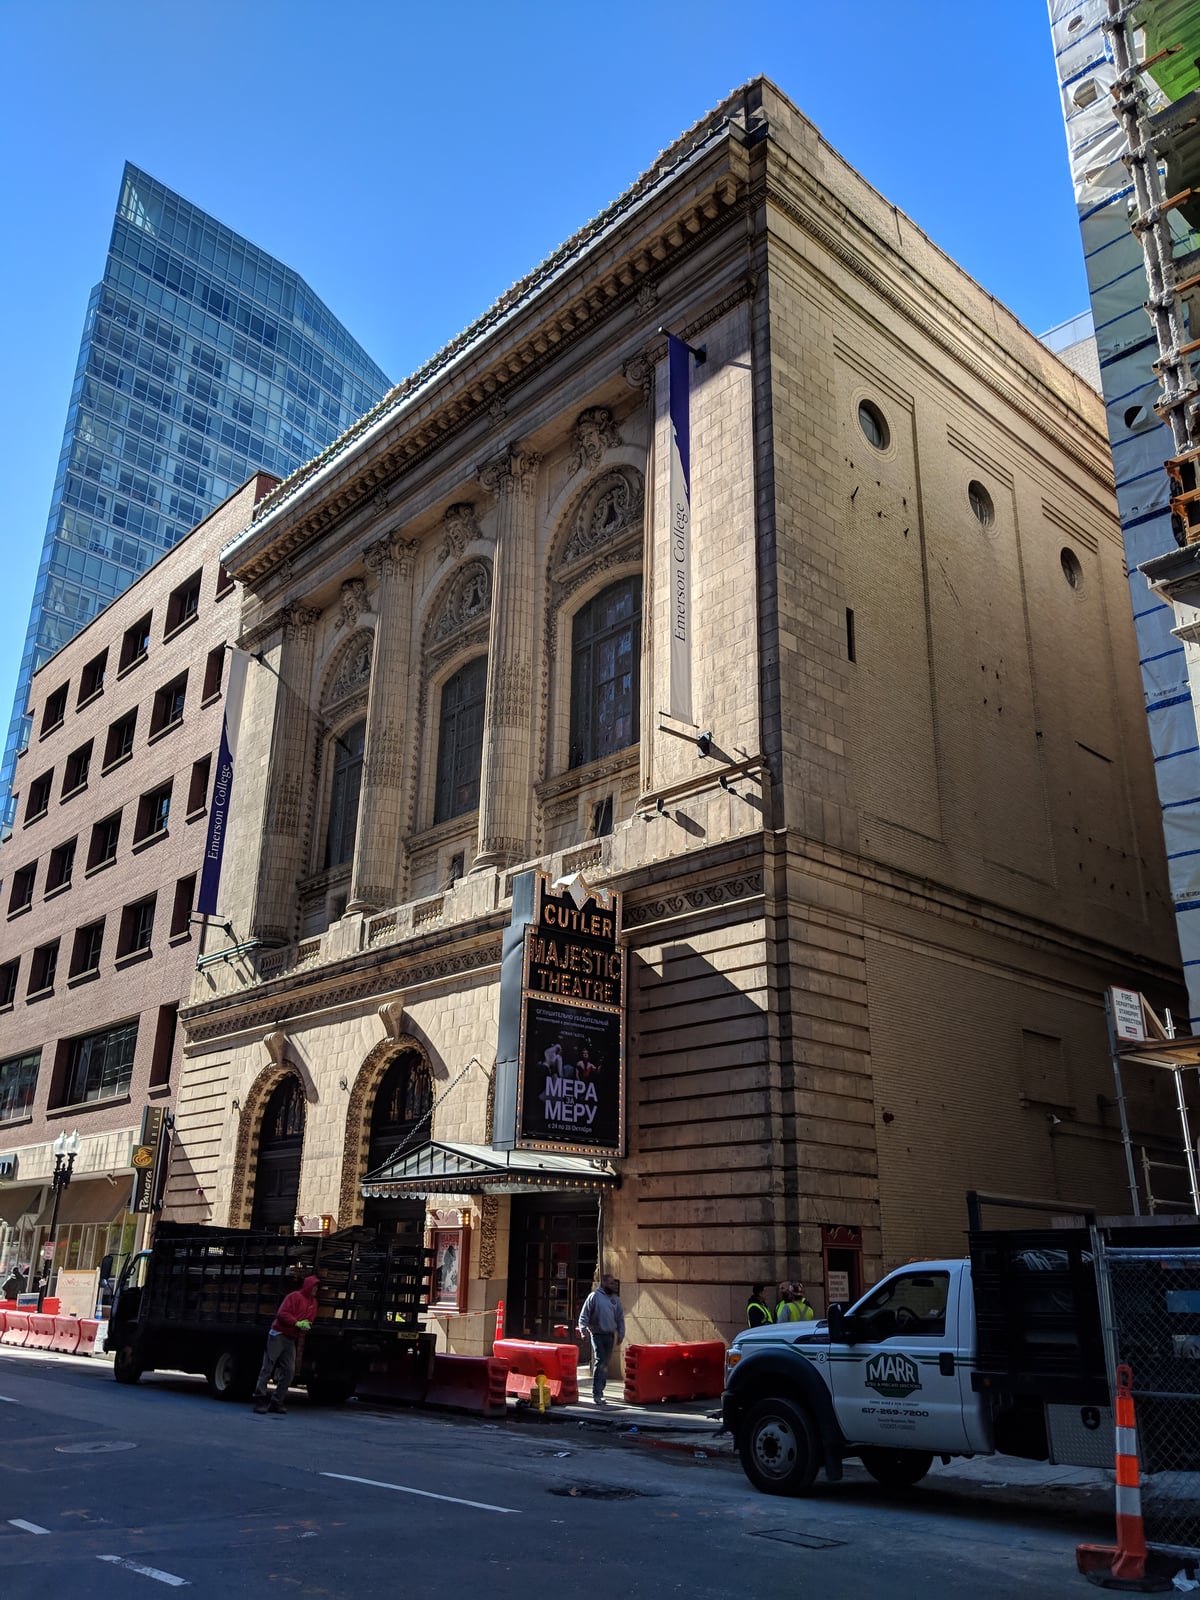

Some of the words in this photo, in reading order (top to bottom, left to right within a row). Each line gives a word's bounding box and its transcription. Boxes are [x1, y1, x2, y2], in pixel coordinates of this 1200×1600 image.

[673, 503, 689, 563] College
[674, 569, 686, 642] Emerson
[214, 764, 232, 806] College
[207, 810, 224, 860] Emerson
[544, 903, 612, 938] CUTLER
[529, 934, 621, 980] MAJESTIC
[537, 968, 614, 1003] THEATRE
[1120, 992, 1133, 1002] FIRE
[1115, 999, 1140, 1010] DEPARTMENT
[1118, 1015, 1142, 1026] CONNECTION
[545, 1075, 598, 1102] МЕРА
[565, 1097, 575, 1105] ЗА
[544, 1099, 598, 1124] МЕРУ
[139, 1170, 153, 1210] Panera
[150, 1109, 160, 1144] BREAD
[869, 1356, 916, 1383] MARR
[861, 1407, 929, 1417] 617-269-7200
